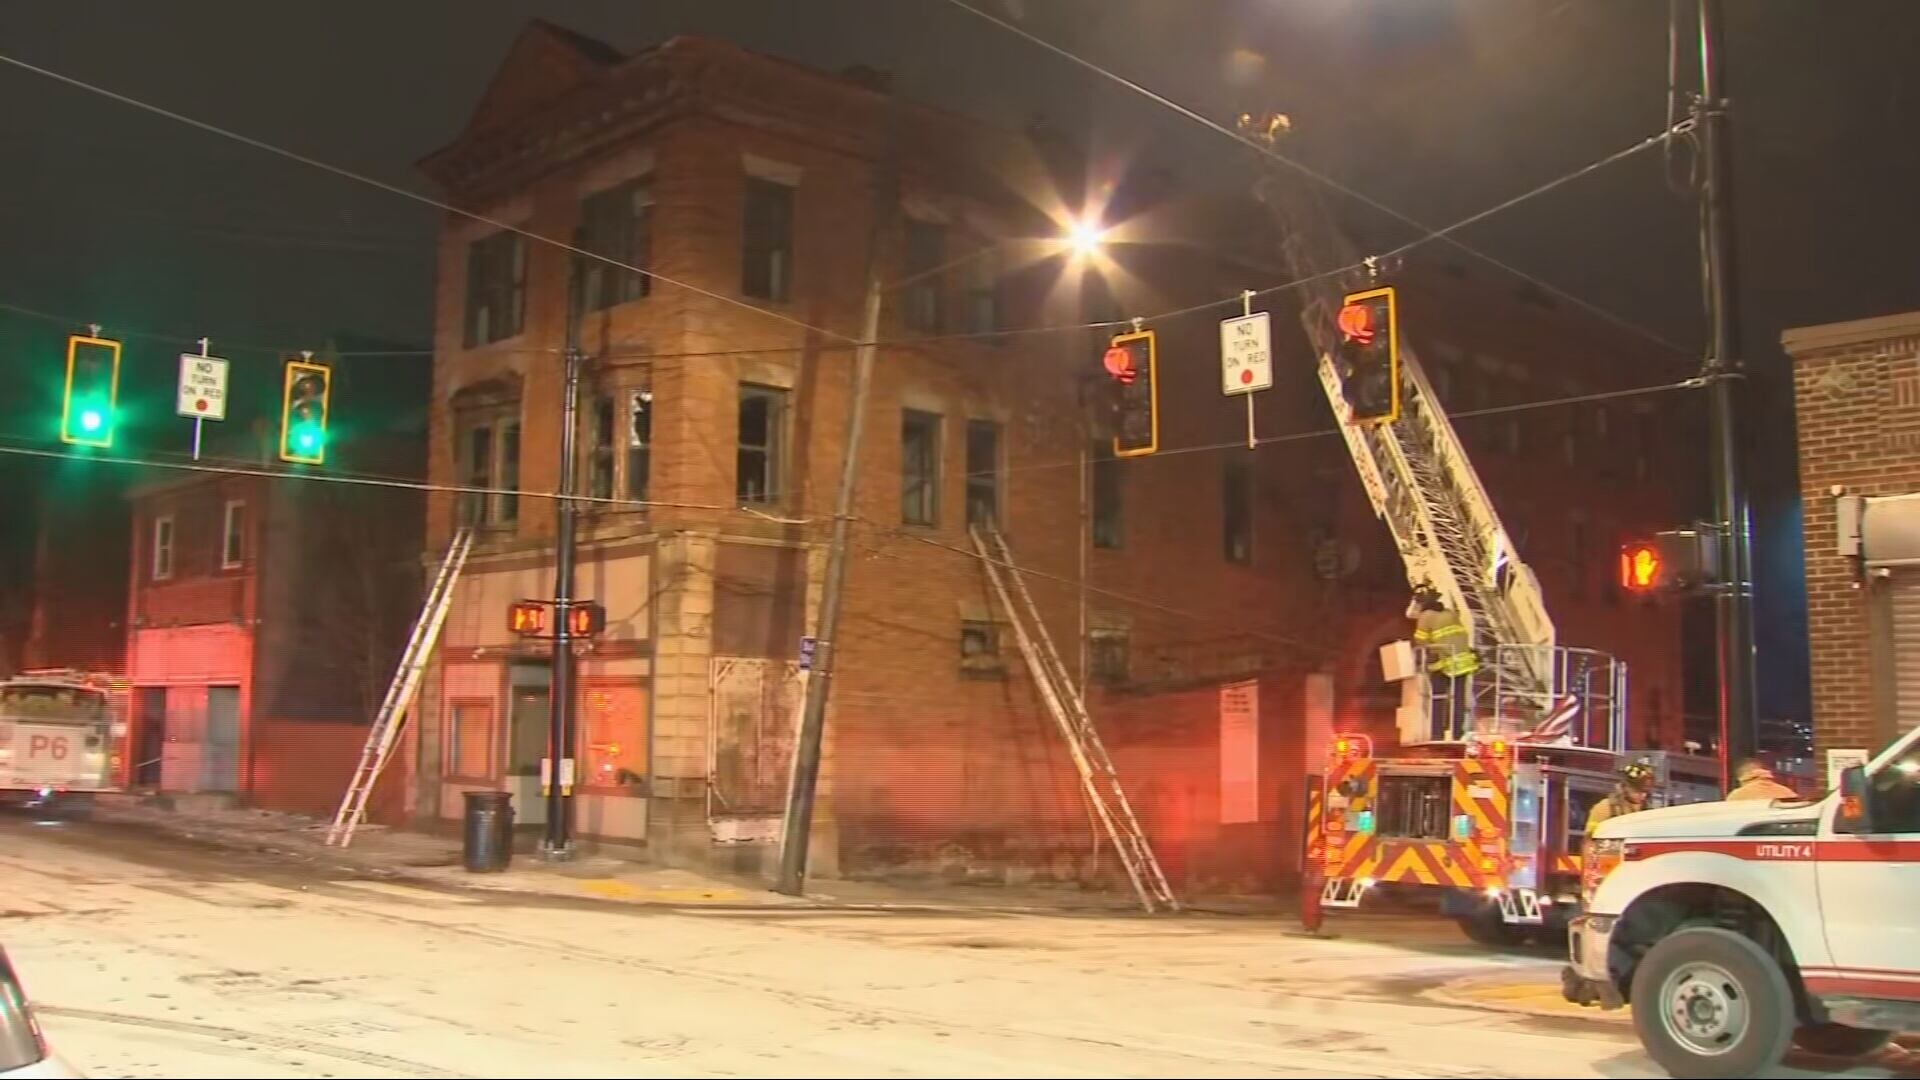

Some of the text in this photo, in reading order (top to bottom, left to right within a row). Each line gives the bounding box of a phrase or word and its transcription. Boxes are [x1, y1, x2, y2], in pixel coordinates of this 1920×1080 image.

[1237, 323, 1252, 335] NO
[1227, 351, 1267, 368] ON RED
[196, 362, 213, 374] NO
[29, 735, 68, 761] P6
[1756, 845, 1812, 858] UTILITY 4
